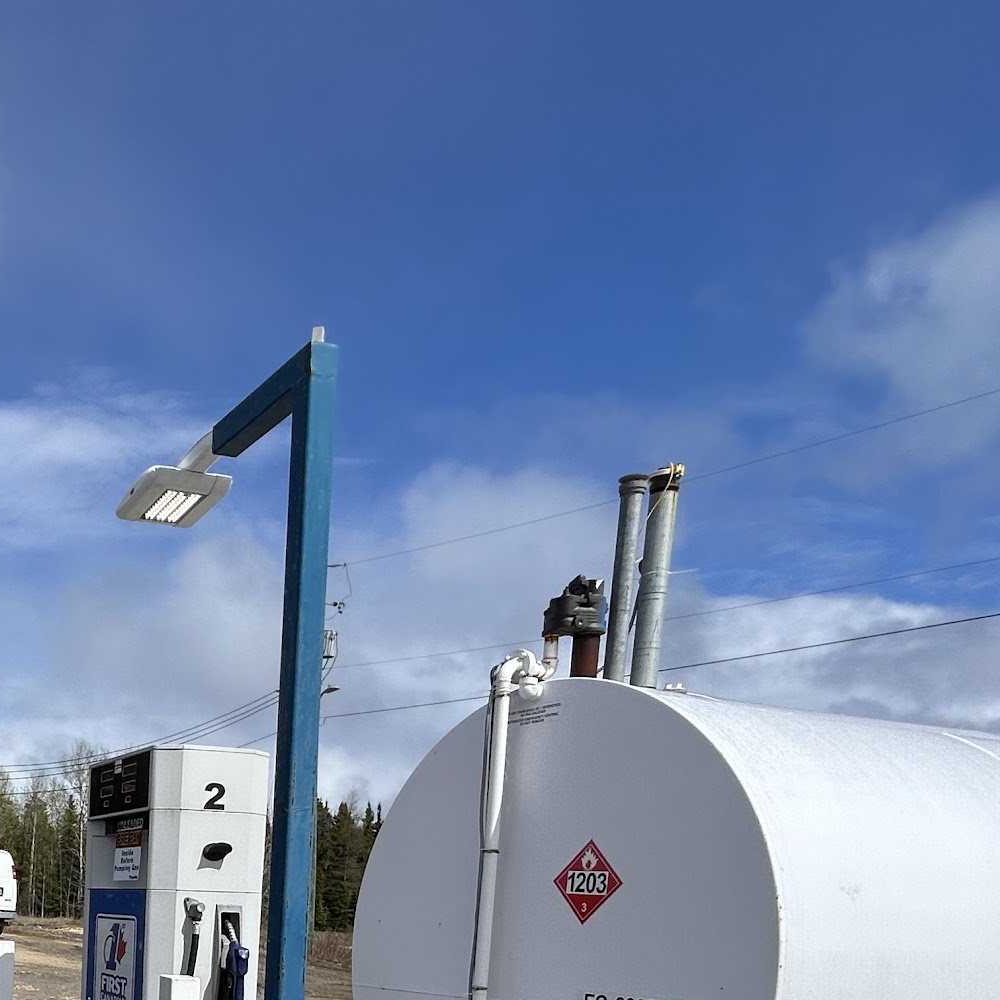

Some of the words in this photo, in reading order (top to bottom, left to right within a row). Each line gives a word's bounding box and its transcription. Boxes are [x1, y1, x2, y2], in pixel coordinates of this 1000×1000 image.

[203, 782, 226, 811] 2
[567, 872, 608, 894] 1203
[580, 902, 588, 913] 3
[101, 974, 127, 997] FIRST
